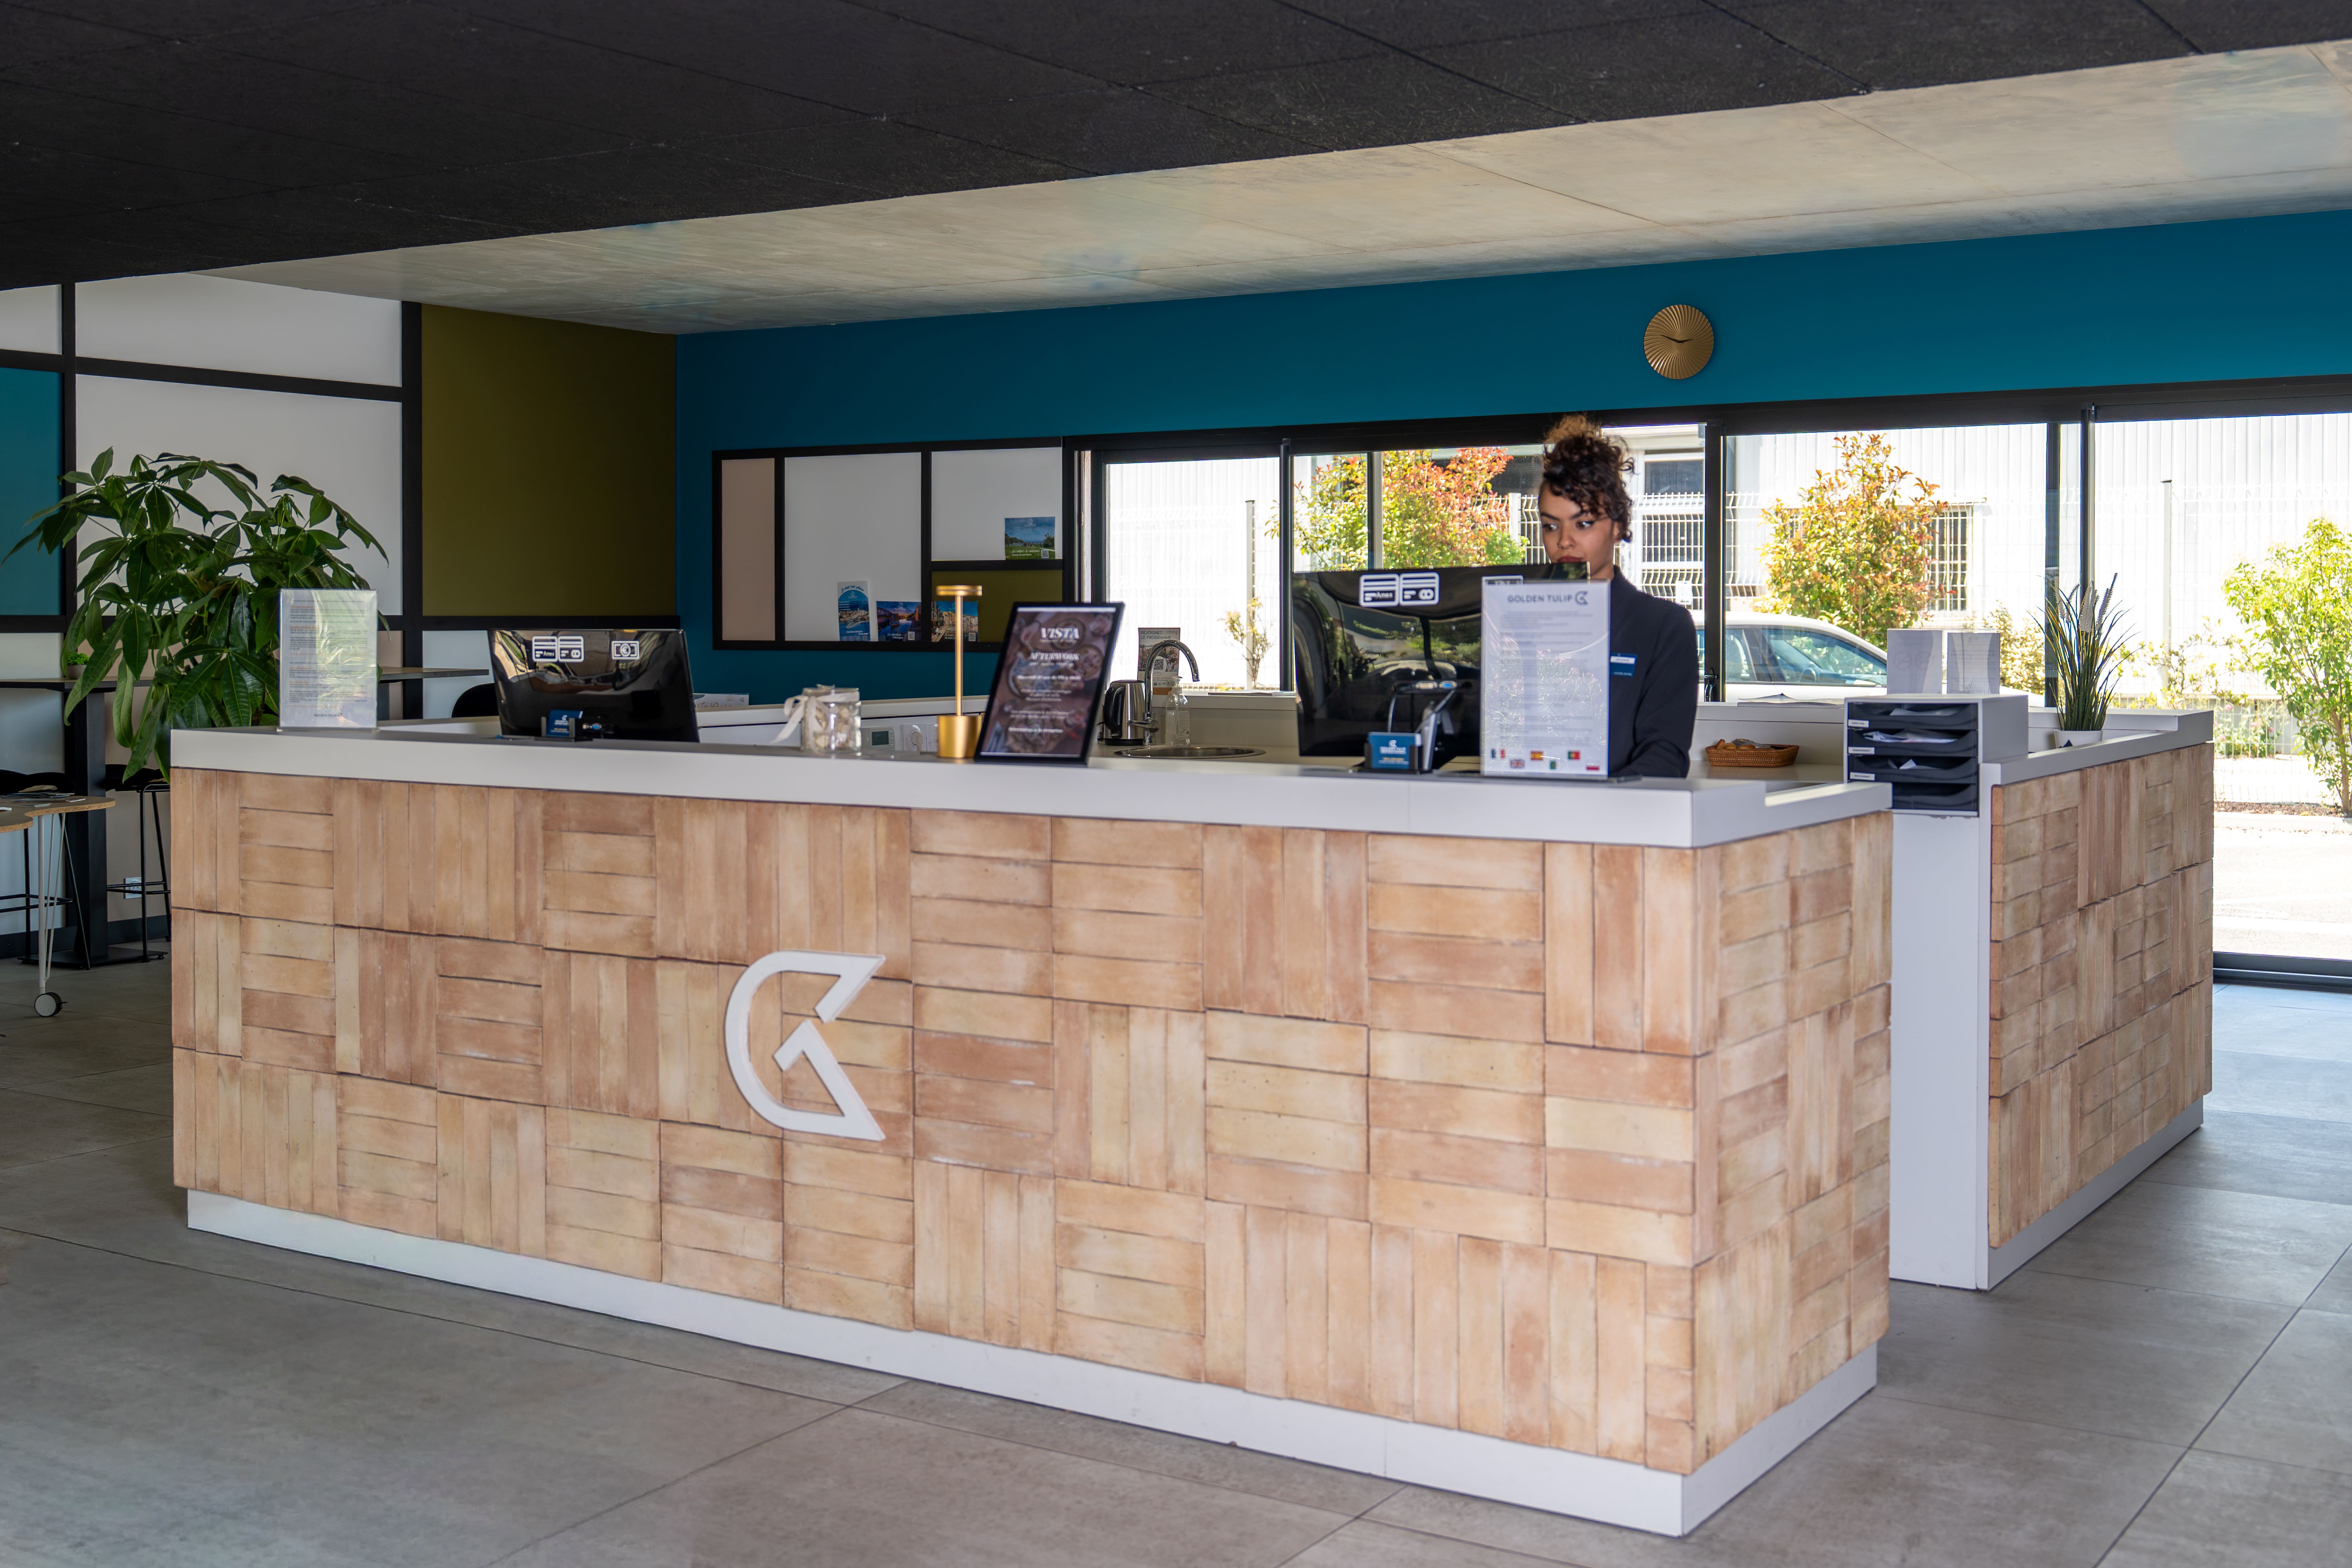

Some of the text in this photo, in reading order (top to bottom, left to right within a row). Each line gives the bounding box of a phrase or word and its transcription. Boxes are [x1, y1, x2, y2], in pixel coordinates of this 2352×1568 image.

[1508, 594, 1573, 603] GOLDEN TULIP
[1041, 627, 1080, 639] VISTA
